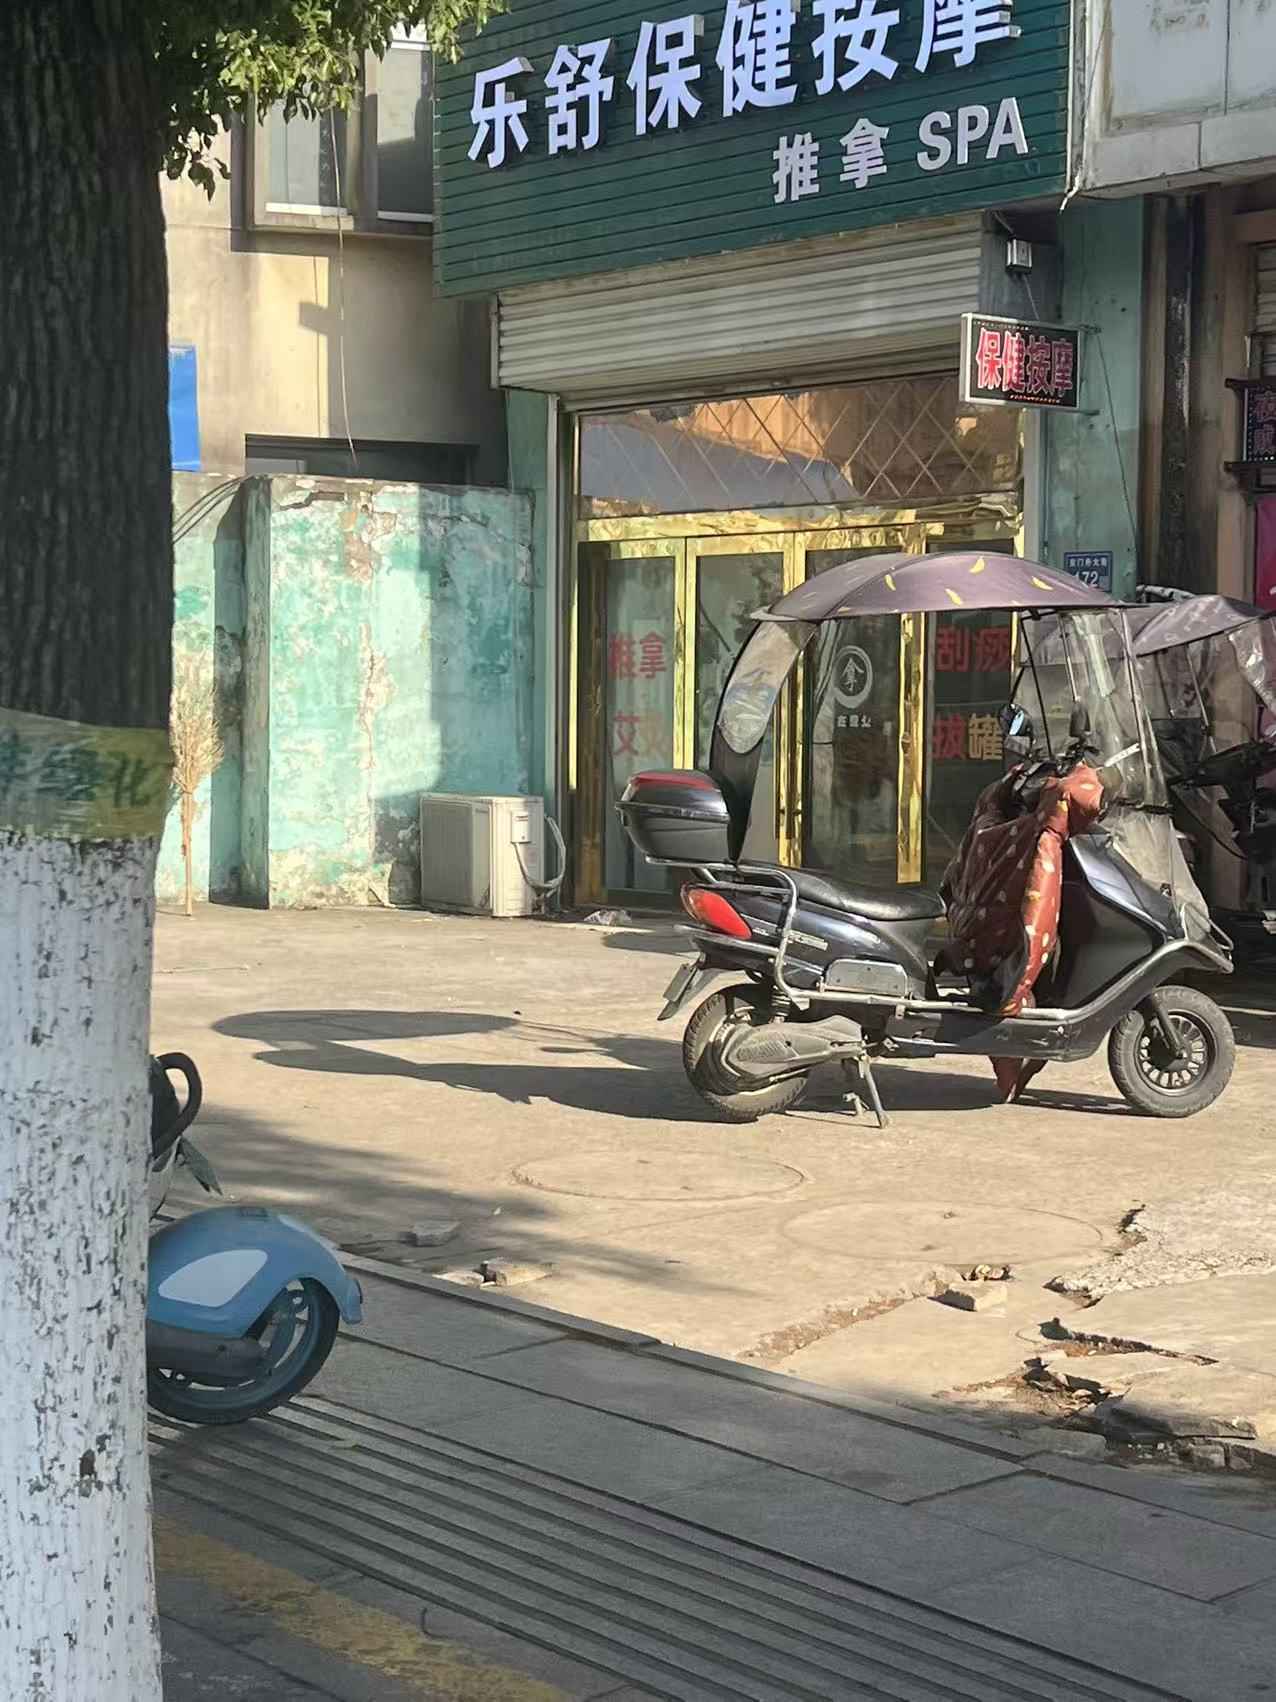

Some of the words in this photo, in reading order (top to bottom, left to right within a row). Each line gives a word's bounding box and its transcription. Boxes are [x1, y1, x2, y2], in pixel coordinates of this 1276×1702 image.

[468, 0, 1022, 169] 乐舒保健按摩
[772, 118, 888, 204] 推拿
[917, 96, 1029, 172] SPA
[976, 327, 1073, 398] 保健按摩
[608, 632, 667, 680] 推拿
[932, 712, 1004, 761] 拔罐
